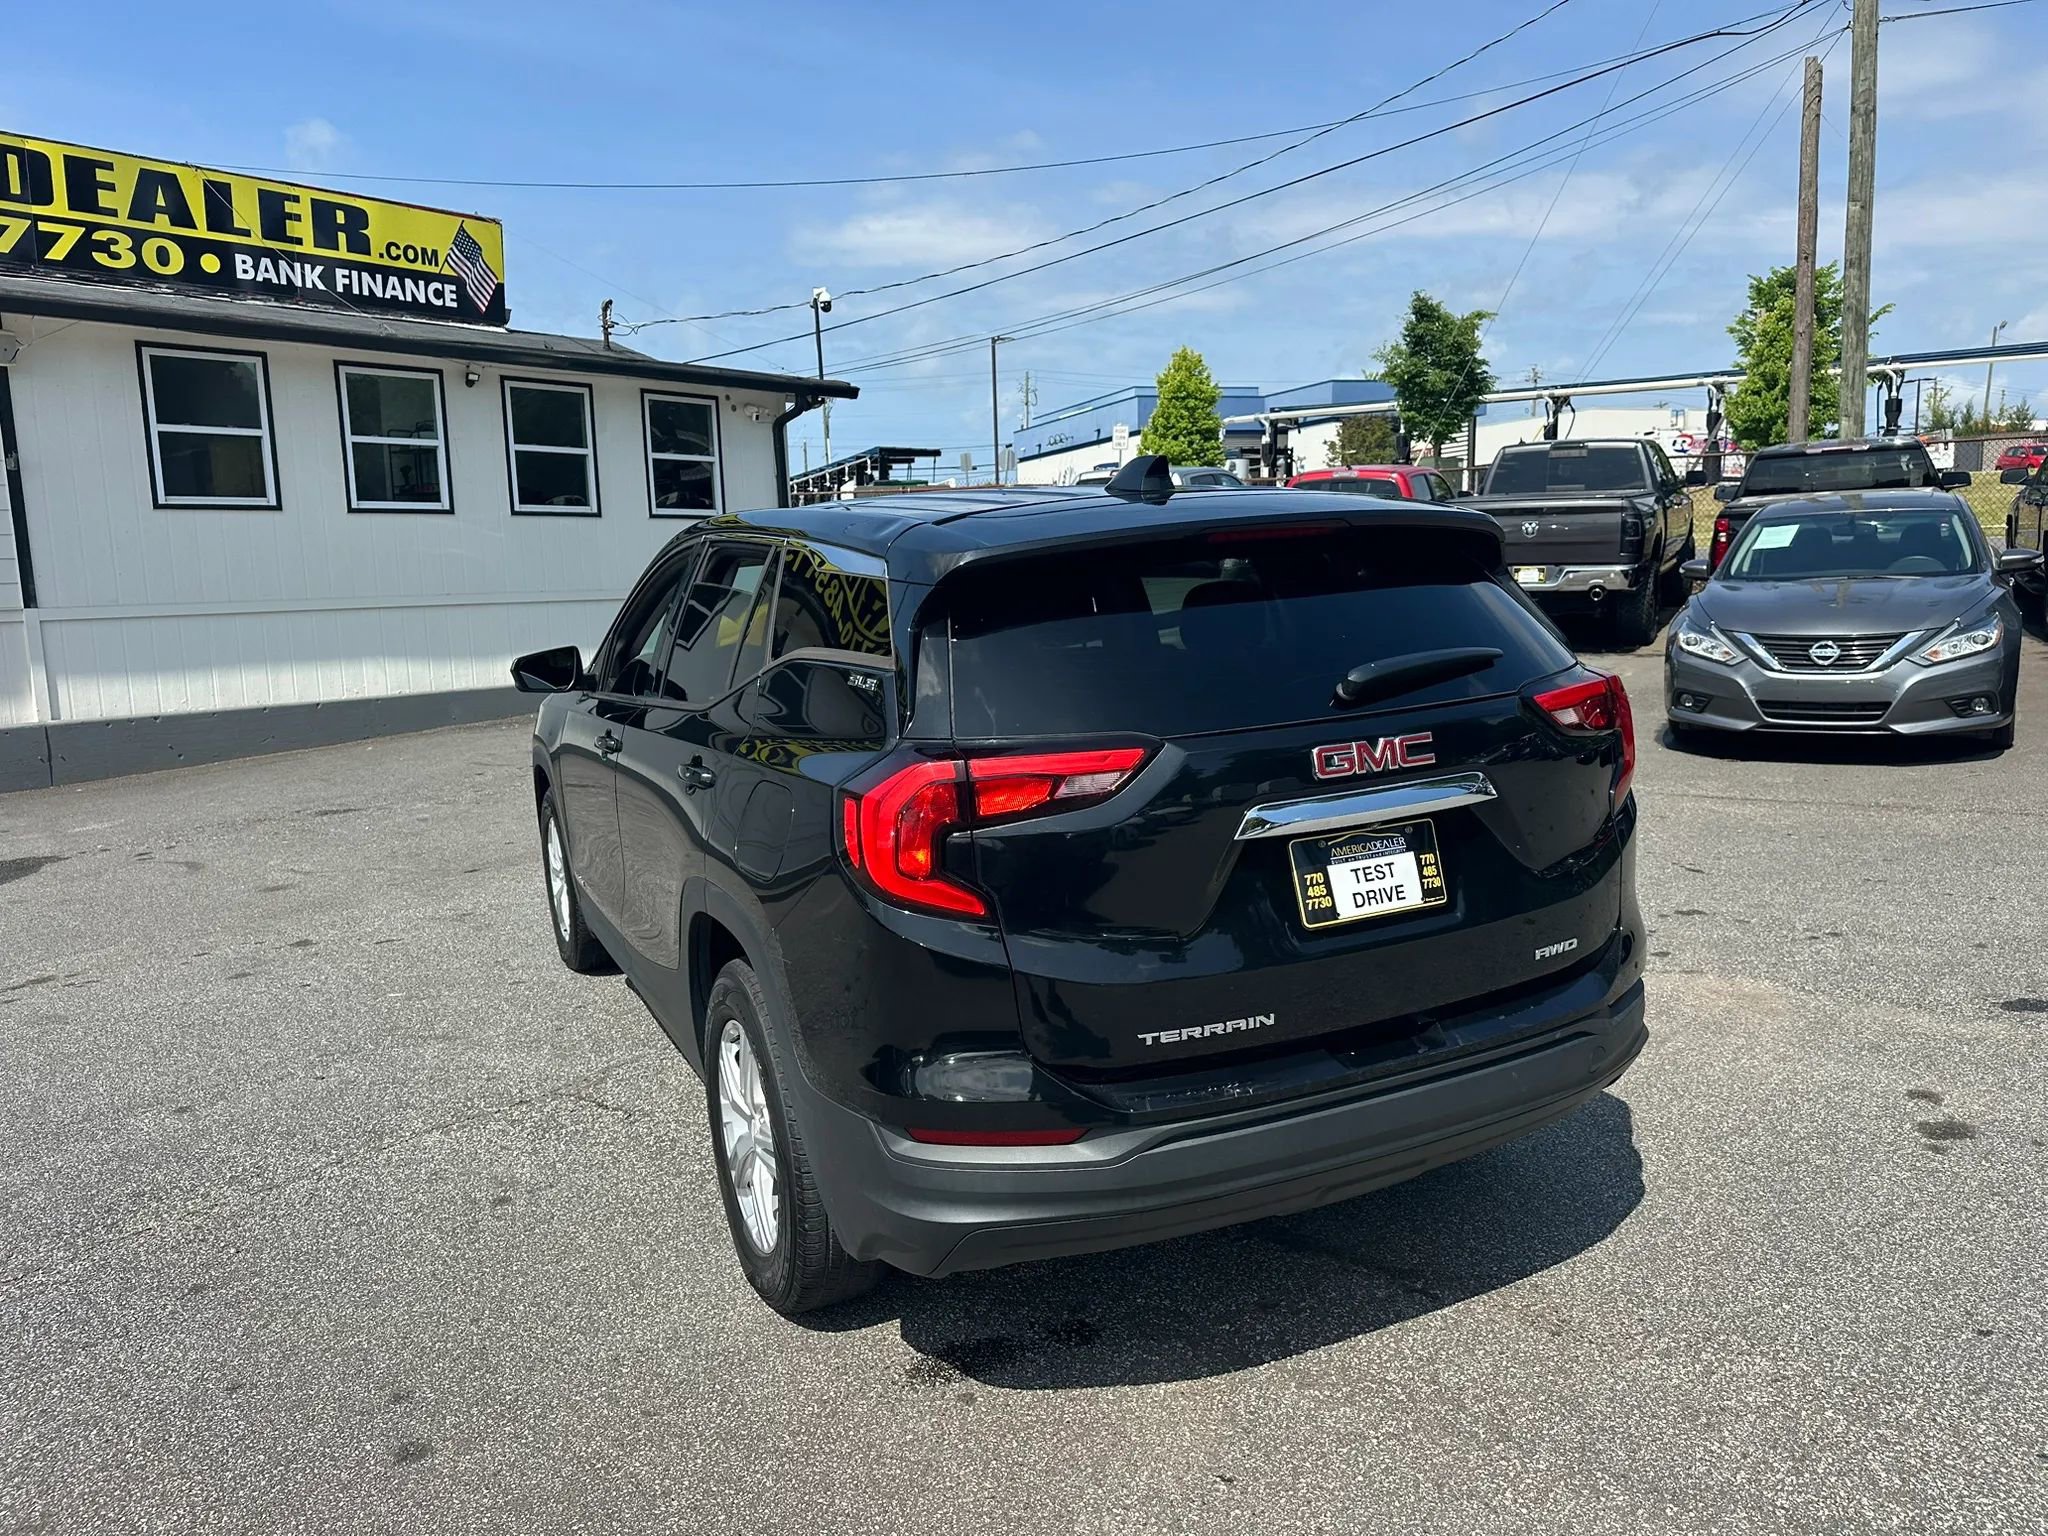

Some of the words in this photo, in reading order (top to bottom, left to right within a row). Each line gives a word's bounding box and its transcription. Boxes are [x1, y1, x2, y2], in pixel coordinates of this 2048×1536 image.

[234, 253, 326, 290] BANK
[335, 268, 458, 308] FINANCE
[1311, 731, 1436, 779] GMC
[1420, 853, 1435, 865] 770
[1304, 872, 1324, 885] 770
[1350, 862, 1394, 884] TEST
[1422, 865, 1437, 877] 485
[1307, 884, 1327, 897] 485
[1422, 876, 1441, 889] 7730
[1305, 896, 1332, 910] 7730
[1352, 884, 1406, 908] DRIVE
[1535, 938, 1578, 960] AWD
[1137, 1013, 1275, 1045] TERRAIN
